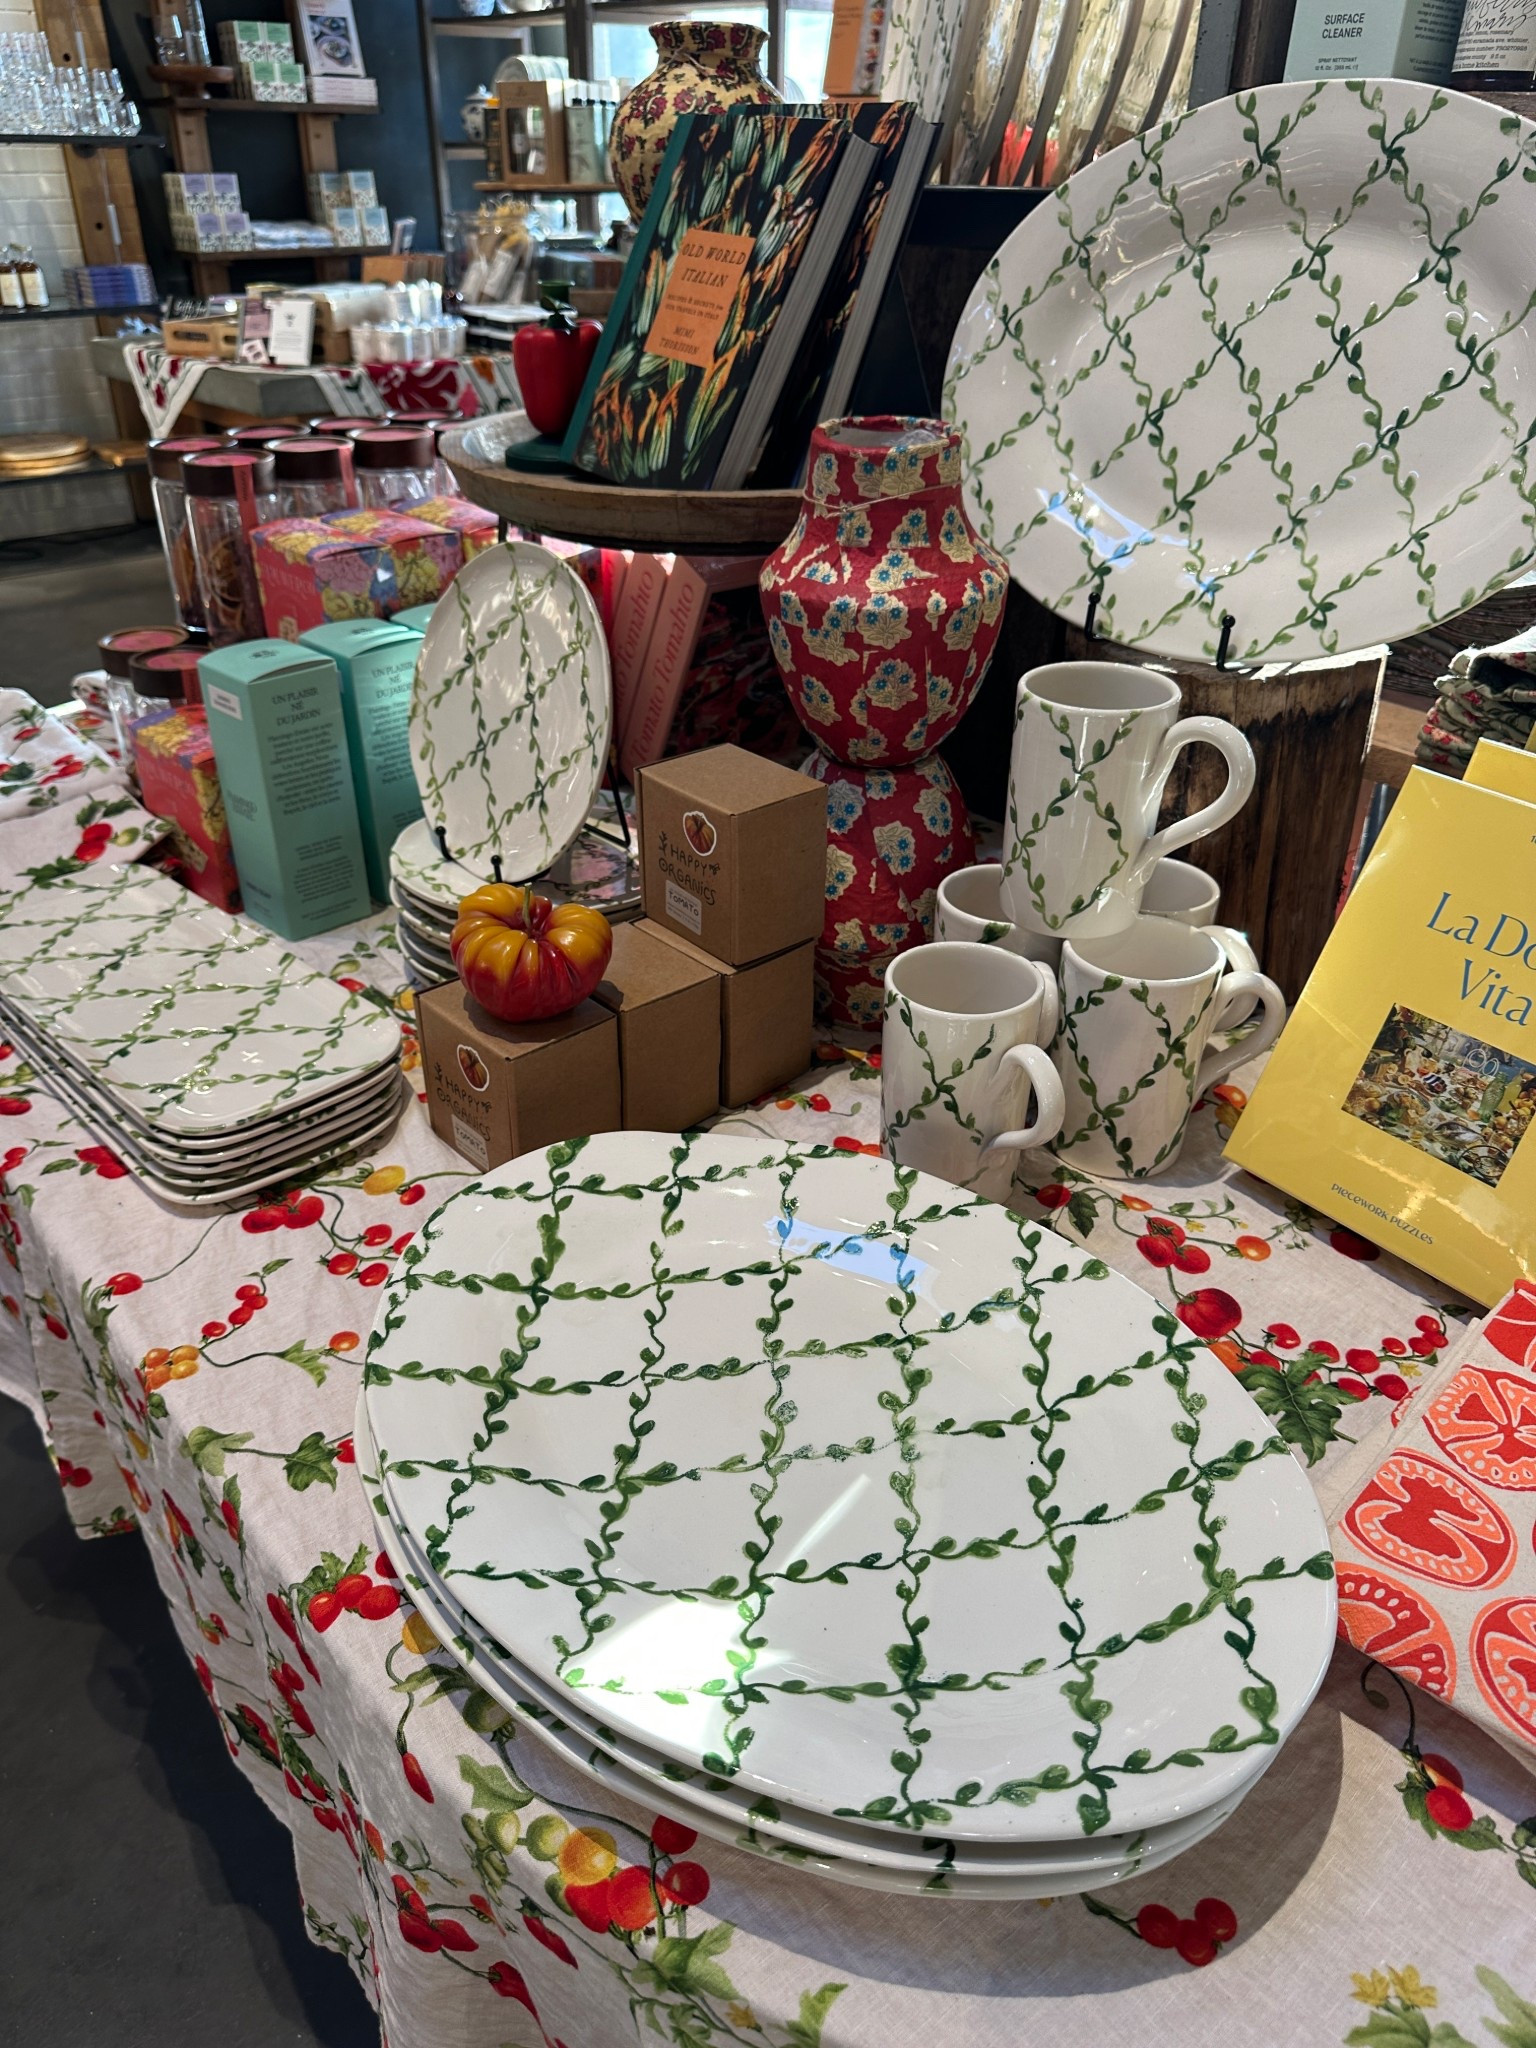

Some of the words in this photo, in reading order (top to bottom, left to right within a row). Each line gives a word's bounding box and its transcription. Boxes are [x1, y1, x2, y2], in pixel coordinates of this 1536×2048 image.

[1324, 12, 1365, 25] SURFACE
[1322, 27, 1363, 39] CLEANER
[682, 243, 704, 259] OLD
[706, 247, 746, 265] WORLD
[681, 268, 728, 288] ITALIAN
[673, 326, 695, 338] MIMI
[652, 583, 694, 683] Tomahto
[271, 695, 286, 705] UN
[287, 687, 318, 701] PLAISIR
[276, 717, 290, 726] DU
[291, 709, 321, 725] JARDIN
[630, 686, 665, 762] Tomato
[670, 844, 708, 876] HAPPY
[669, 890, 699, 916] TOMATO
[1426, 892, 1479, 944] La
[1461, 958, 1532, 1026] Vita
[445, 1076, 480, 1112] HAPPY
[455, 1127, 486, 1155] TOMATO
[1331, 1183, 1389, 1221] PIECEWORK
[1390, 1215, 1434, 1245] PUZZLES
